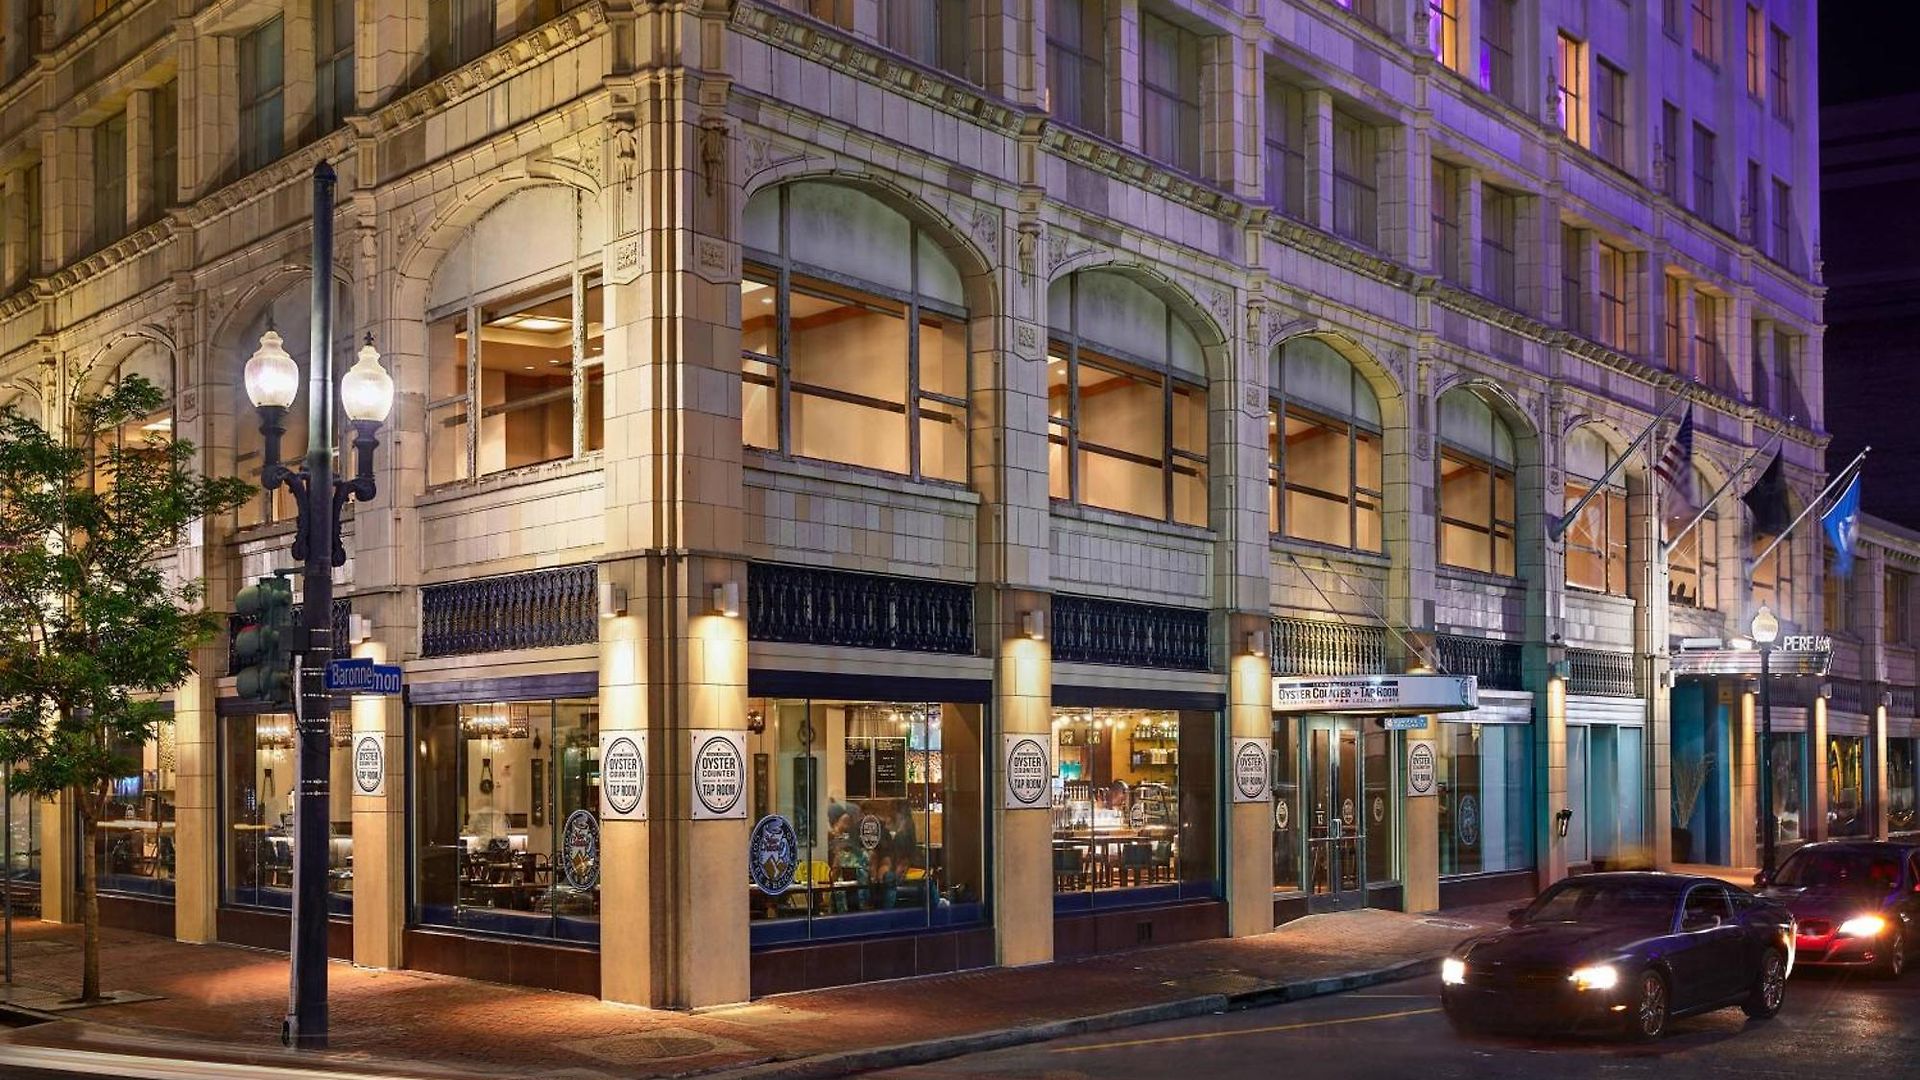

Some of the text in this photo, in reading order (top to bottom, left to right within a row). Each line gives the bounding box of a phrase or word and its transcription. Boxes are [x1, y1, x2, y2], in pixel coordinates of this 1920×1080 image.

[332, 663, 372, 685] Baronne
[373, 673, 399, 691] mon
[1279, 689, 1311, 700] OYSTER
[1360, 687, 1376, 698] TAP
[1376, 686, 1399, 698] ROOM
[609, 757, 637, 770] OYSTER
[702, 757, 736, 770] OYSTER
[1014, 757, 1042, 767] OYSTER
[1240, 757, 1262, 767] OYSTER
[702, 770, 736, 778] COUNTER
[609, 784, 637, 797] TAP ROOM
[702, 783, 736, 796] TAP ROOM
[1014, 779, 1042, 789] TAP ROOM
